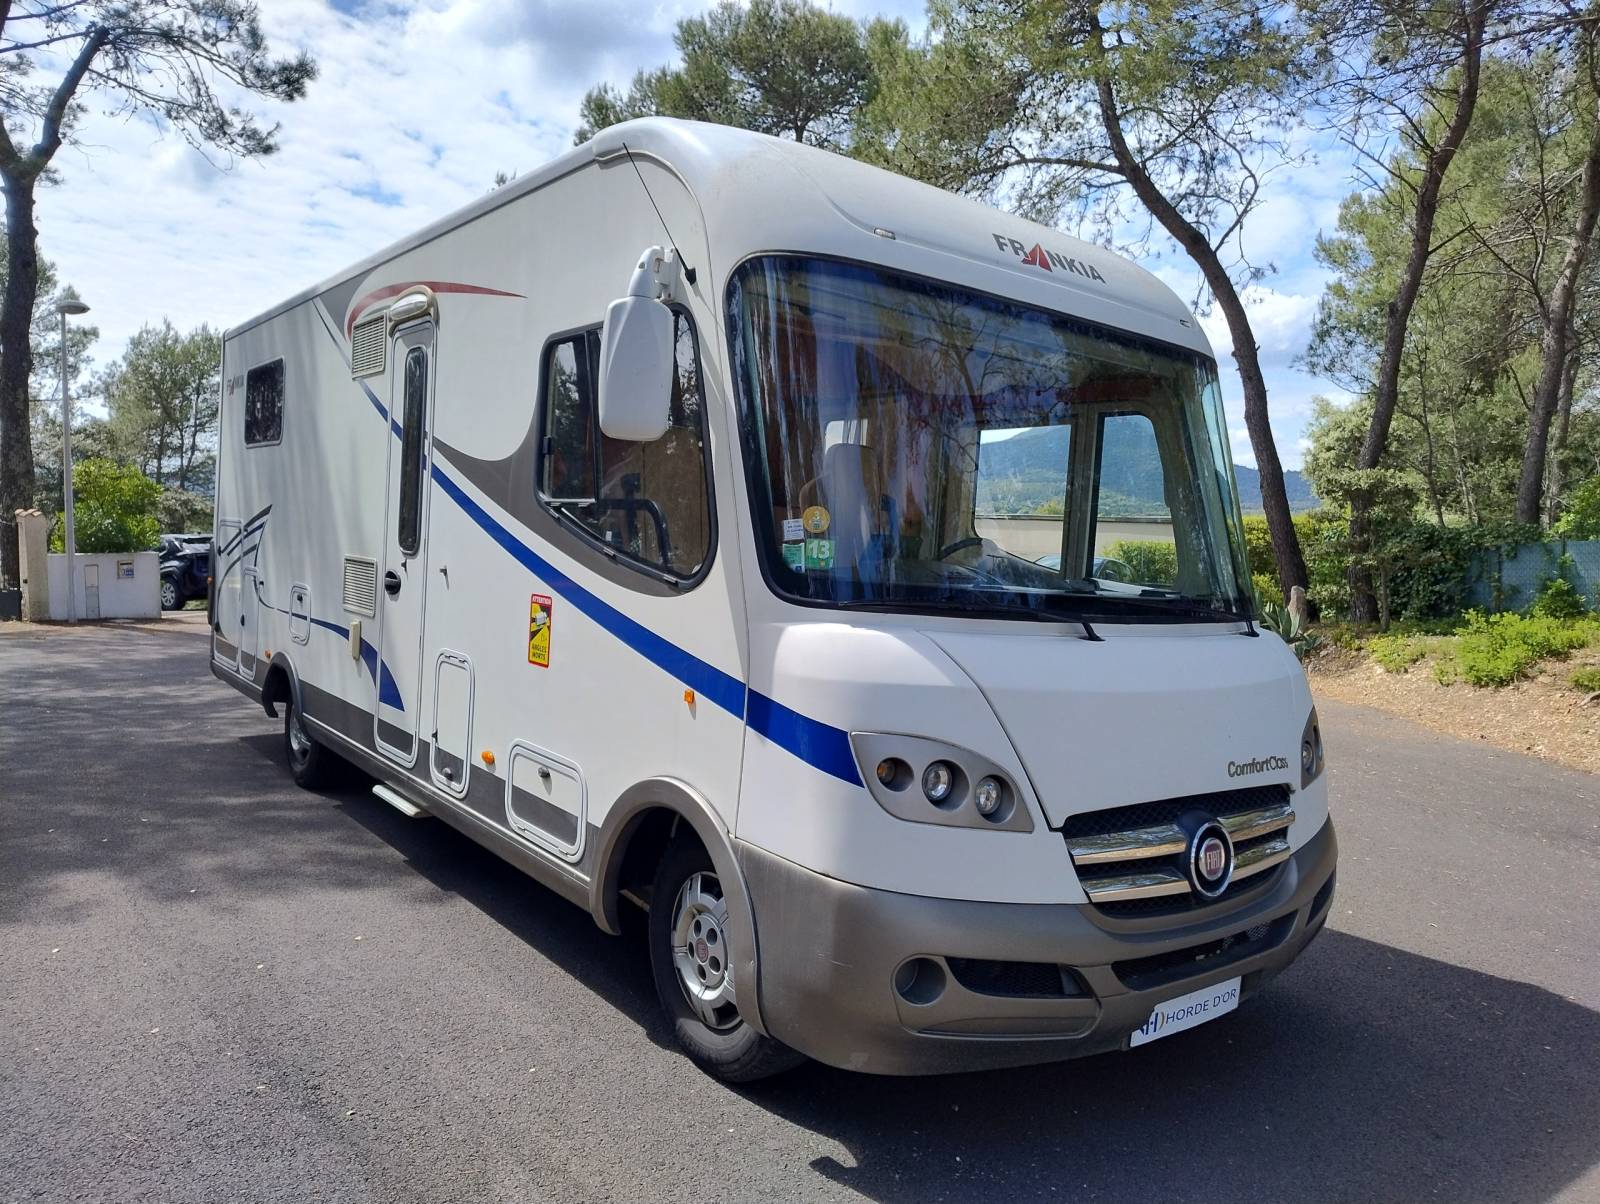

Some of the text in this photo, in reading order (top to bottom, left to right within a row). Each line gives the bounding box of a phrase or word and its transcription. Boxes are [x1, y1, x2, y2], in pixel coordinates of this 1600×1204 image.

[991, 233, 1106, 284] FRANKIA
[808, 540, 830, 559] 13
[1206, 850, 1221, 870] FIAT
[1166, 1000, 1210, 1024] HORDE
[1213, 988, 1237, 1007] D'OR
